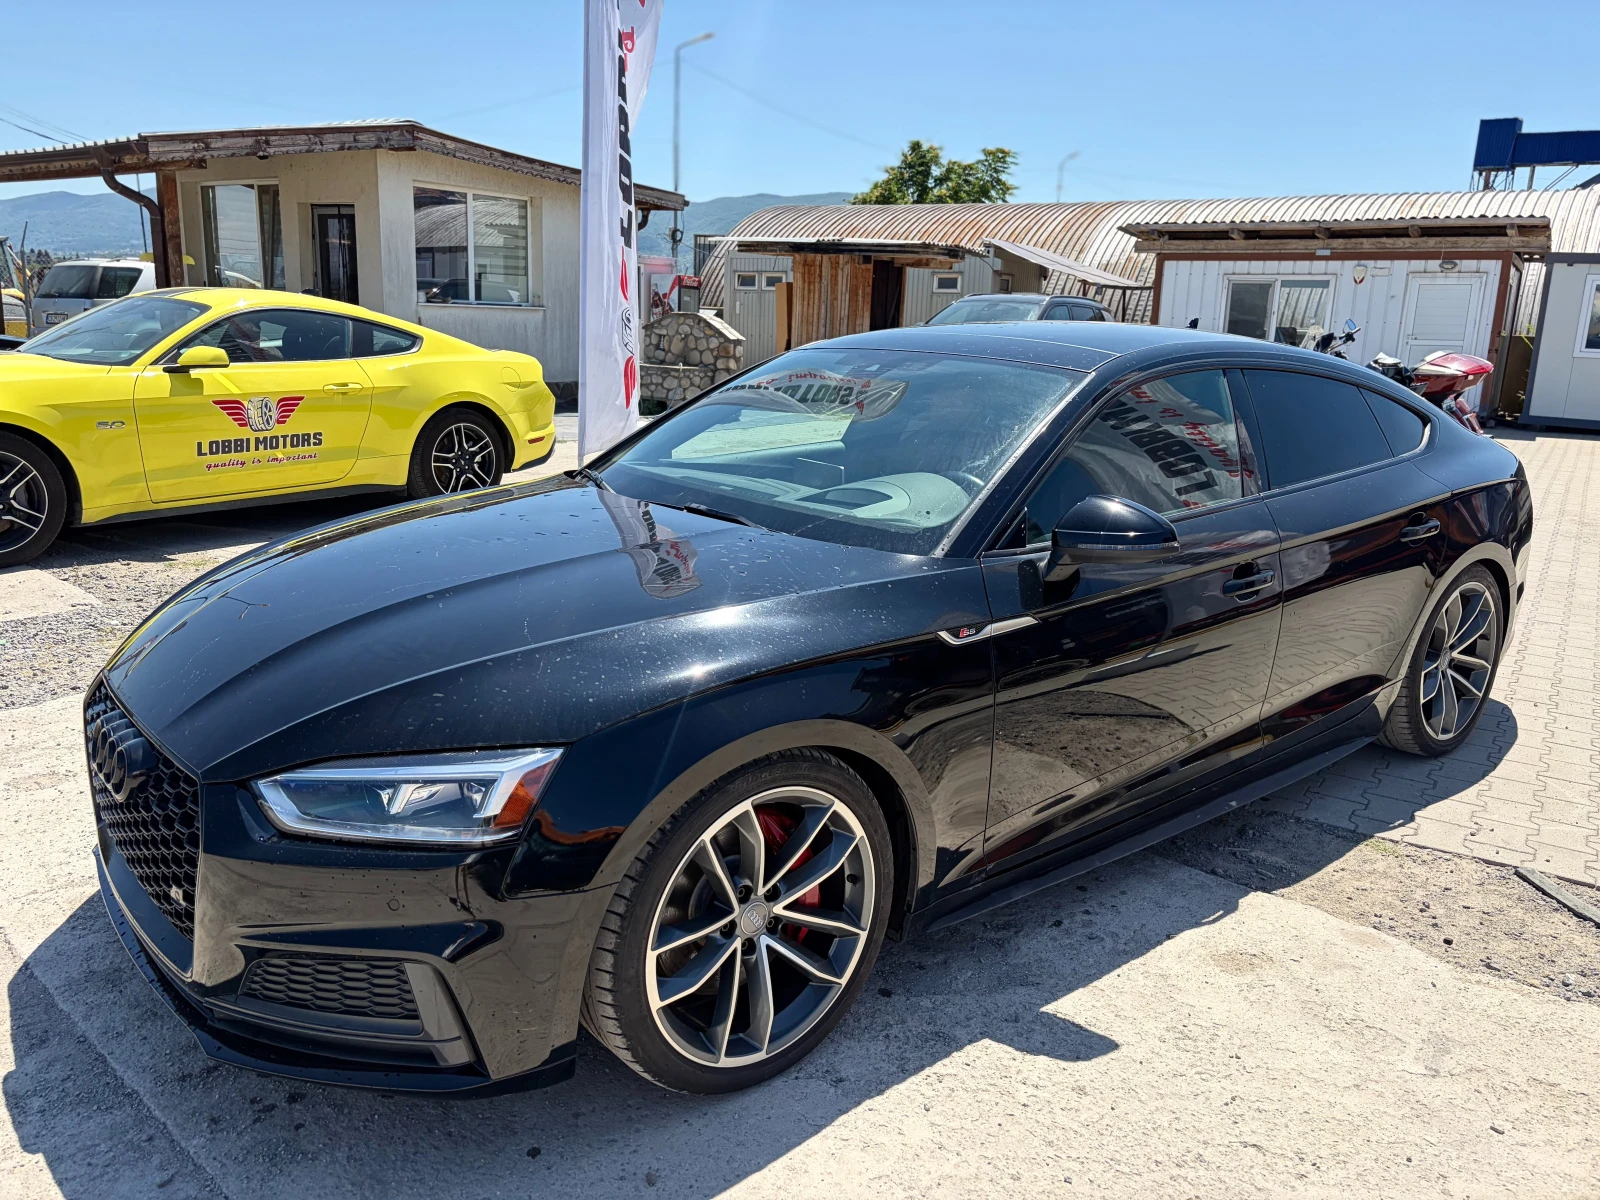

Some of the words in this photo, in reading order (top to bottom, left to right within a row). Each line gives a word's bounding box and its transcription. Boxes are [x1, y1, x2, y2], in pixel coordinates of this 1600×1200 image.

[196, 440, 251, 457] LOBBI
[254, 431, 324, 452] MOTORS
[205, 457, 248, 472] quality
[252, 456, 263, 465] is
[266, 451, 319, 465] important
